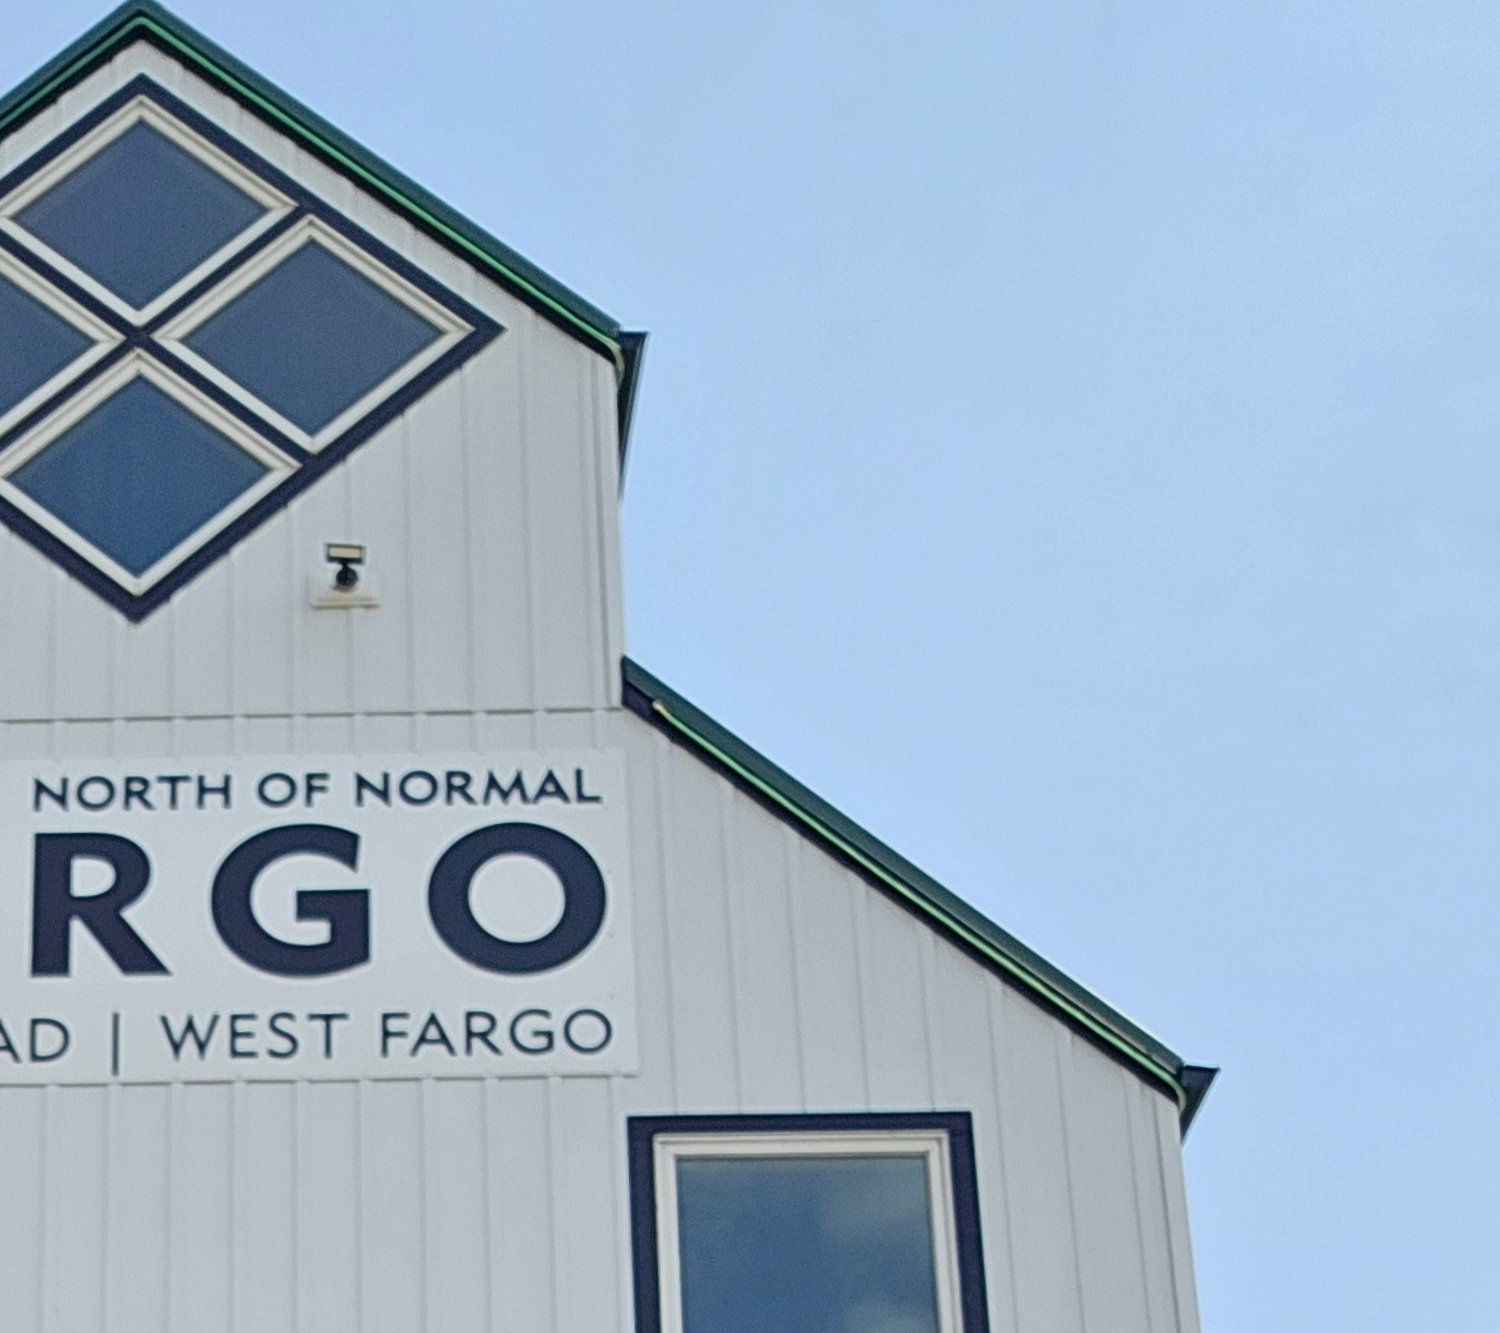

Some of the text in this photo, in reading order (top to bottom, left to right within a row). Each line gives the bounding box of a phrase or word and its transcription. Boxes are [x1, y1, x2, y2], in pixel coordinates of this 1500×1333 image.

[32, 766, 604, 813] NORTH OF NORMAL
[159, 1010, 350, 1060] WEST
[380, 1007, 614, 1058] FARGO
